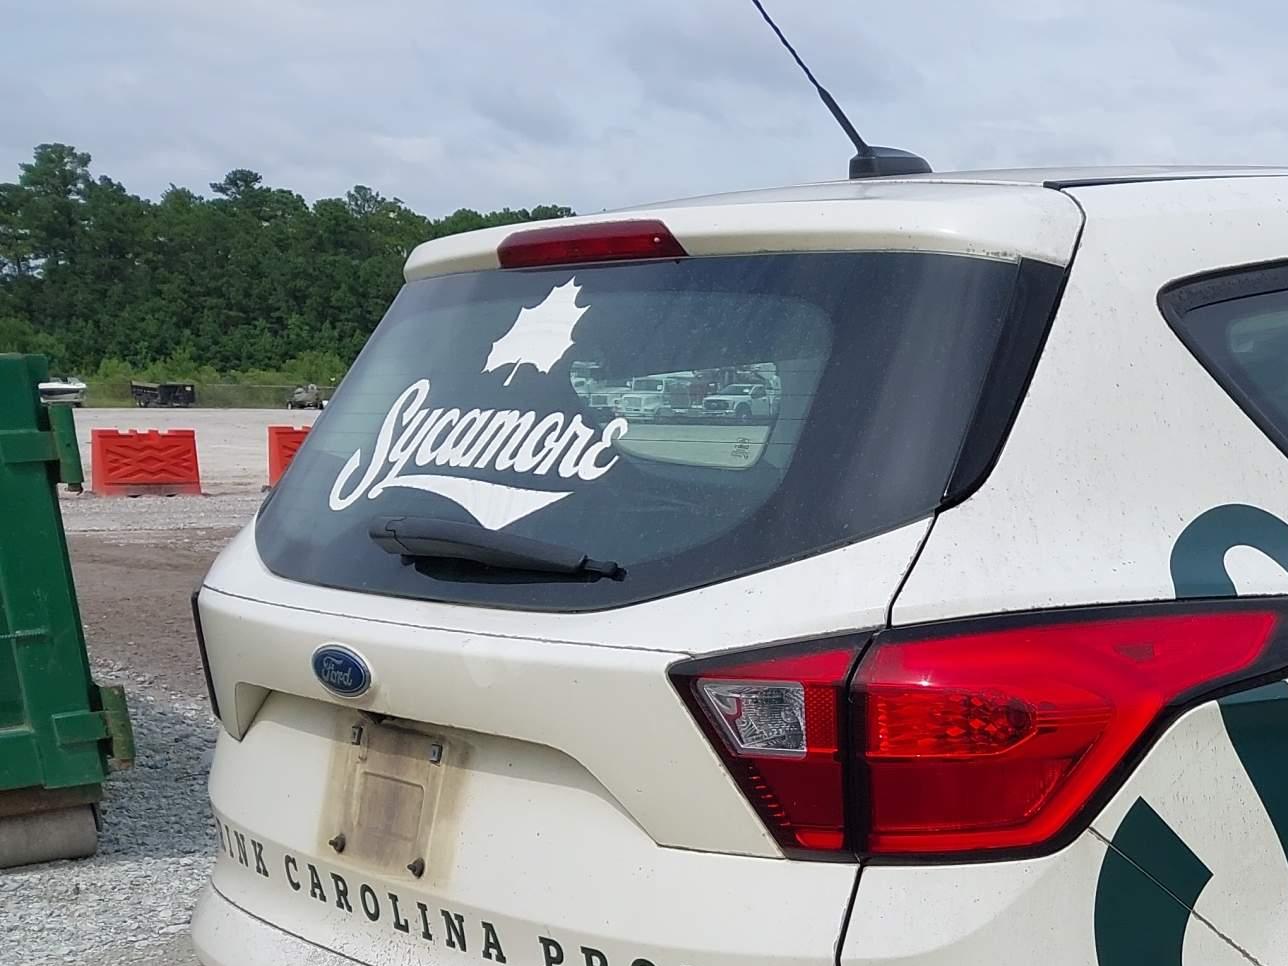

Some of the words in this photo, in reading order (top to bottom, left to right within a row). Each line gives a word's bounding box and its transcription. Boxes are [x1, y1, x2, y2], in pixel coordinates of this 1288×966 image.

[329, 379, 628, 511] Sycamore
[215, 816, 269, 878] INK
[285, 853, 507, 964] CAROLINA
